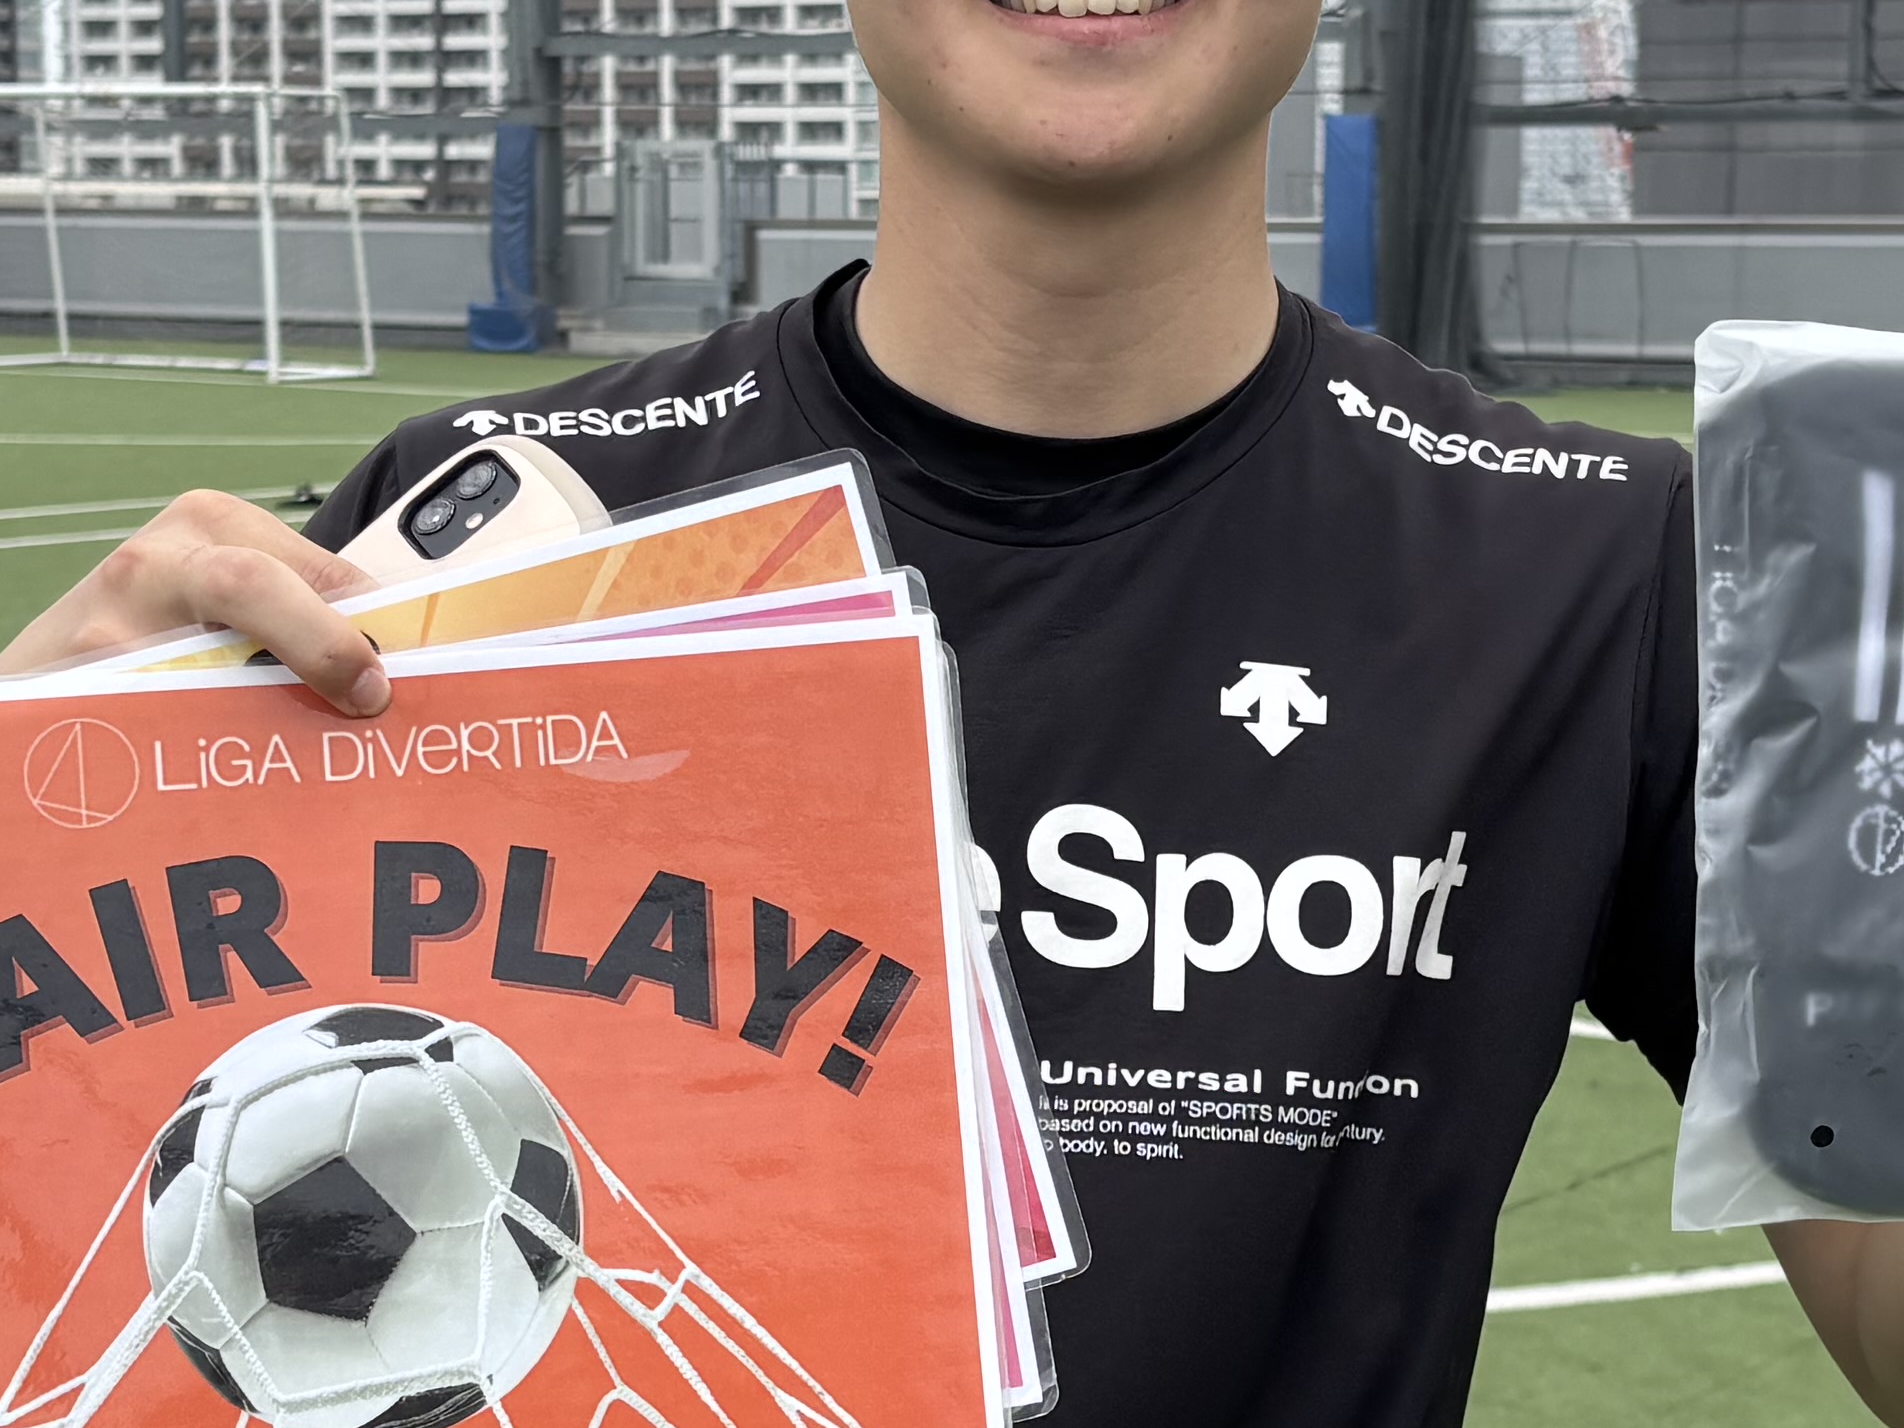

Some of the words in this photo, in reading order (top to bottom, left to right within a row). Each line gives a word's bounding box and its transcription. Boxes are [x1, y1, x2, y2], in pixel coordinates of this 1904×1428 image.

[513, 370, 761, 437] DESCENTE
[1376, 404, 1629, 481] DESCENTE
[968, 803, 1468, 1012] Sport
[370, 840, 915, 1097] PLAY!
[1040, 1059, 1262, 1093] Universal
[1038, 1115, 1095, 1132] based
[1099, 1120, 1123, 1133] on
[1128, 1121, 1167, 1137] new
[1172, 1120, 1259, 1143] functional
[1263, 1127, 1317, 1151] design
[1053, 1095, 1069, 1111] is
[1073, 1097, 1154, 1116] proposal
[1158, 1099, 1176, 1116] of
[1181, 1099, 1273, 1122] "SPORTS
[1278, 1105, 1338, 1127] MODE"
[1113, 1138, 1131, 1155] to
[1136, 1141, 1184, 1160] spirit.
